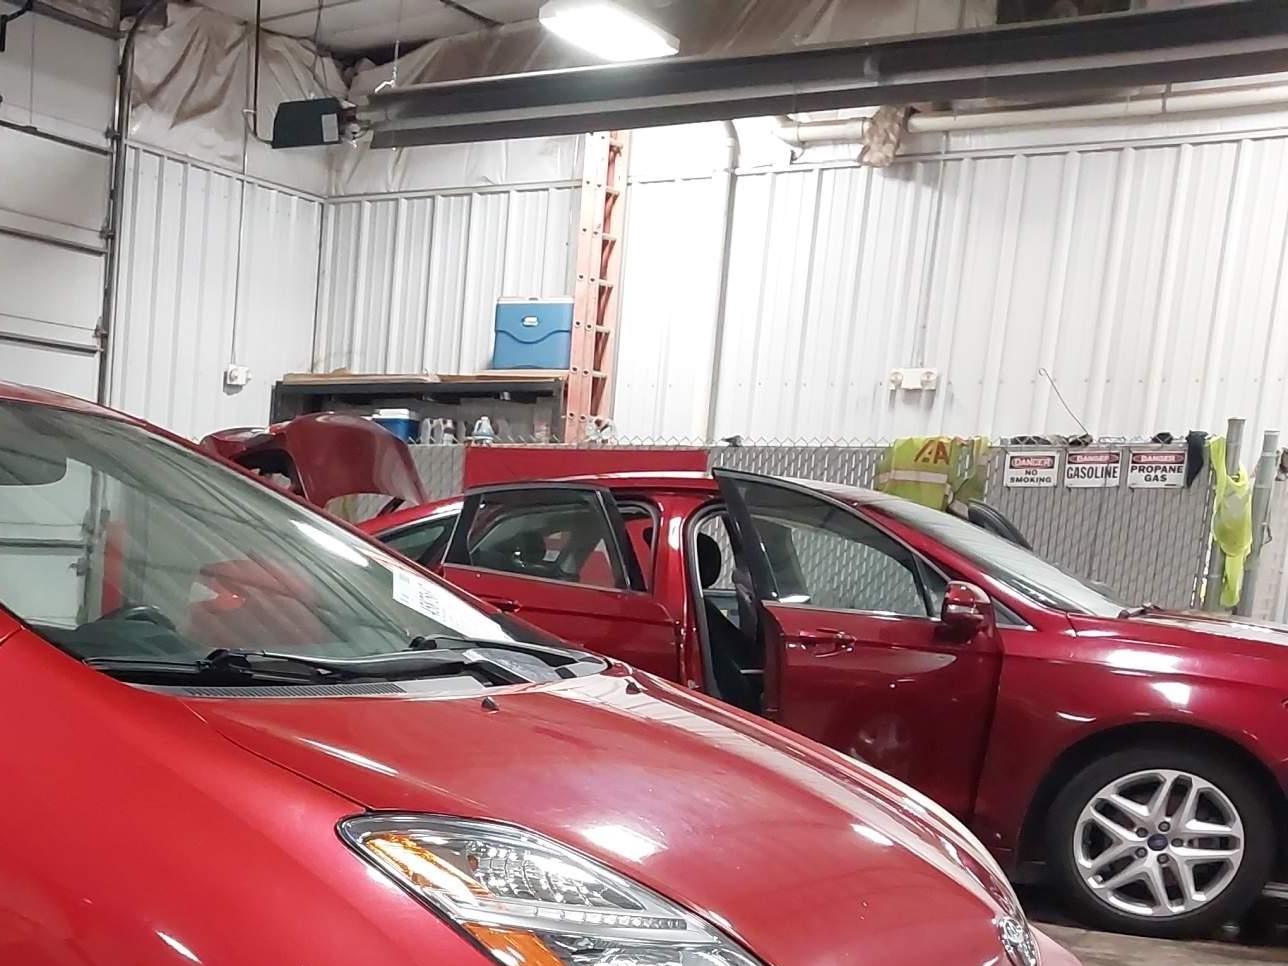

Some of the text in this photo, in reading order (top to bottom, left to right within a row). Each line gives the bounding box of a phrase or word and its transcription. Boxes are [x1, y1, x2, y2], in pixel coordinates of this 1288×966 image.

[1066, 466, 1118, 479] GASOLINE
[1130, 465, 1184, 473] PROPANE
[1144, 474, 1167, 482] GAS
